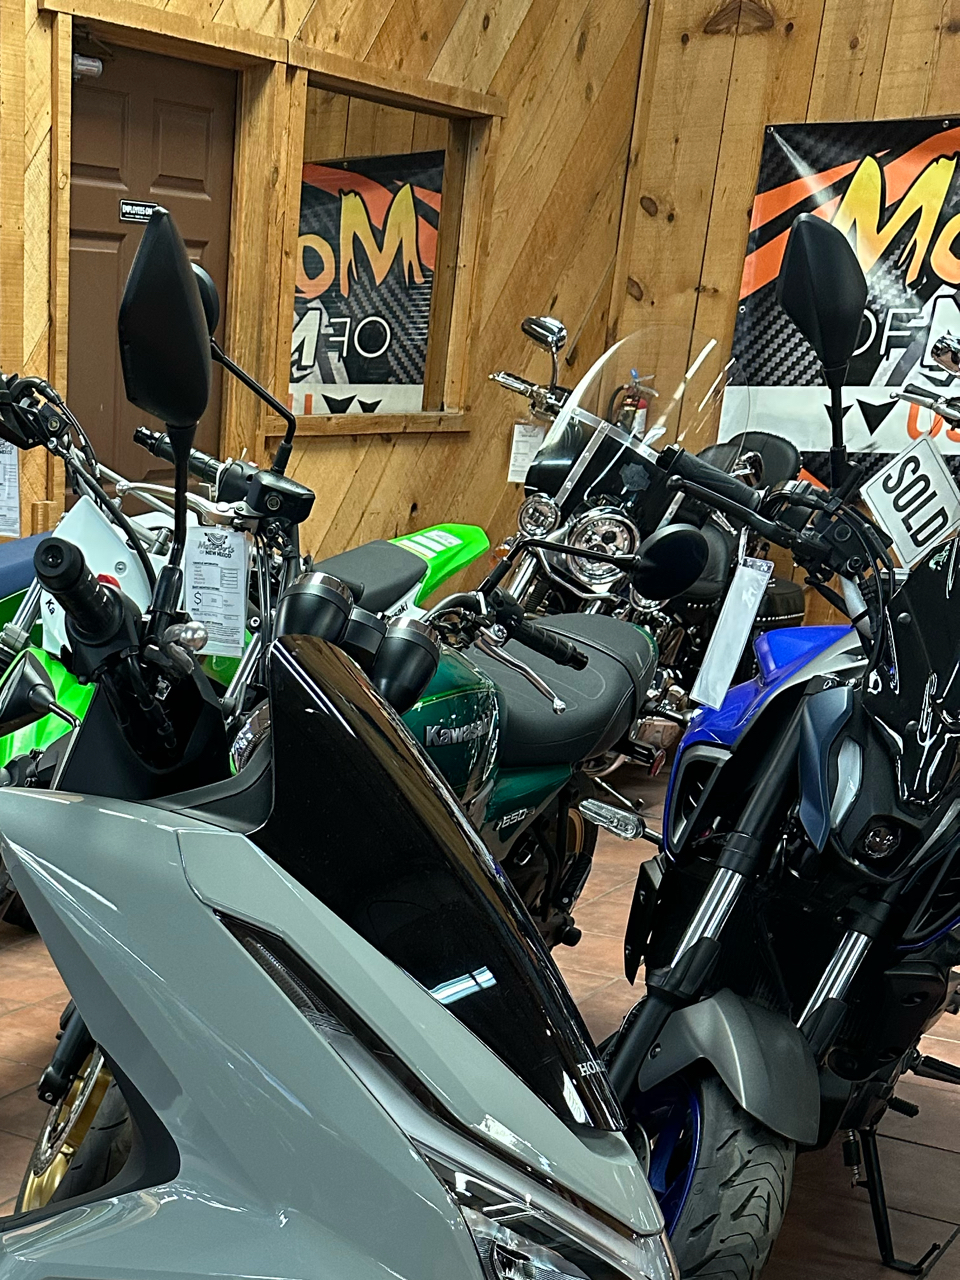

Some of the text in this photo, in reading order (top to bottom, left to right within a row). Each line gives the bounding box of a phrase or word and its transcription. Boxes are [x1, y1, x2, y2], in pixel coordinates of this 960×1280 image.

[122, 204, 145, 215] EMPLOYEES
[882, 455, 949, 548] SOLD
[426, 711, 491, 747] Kawasaki
